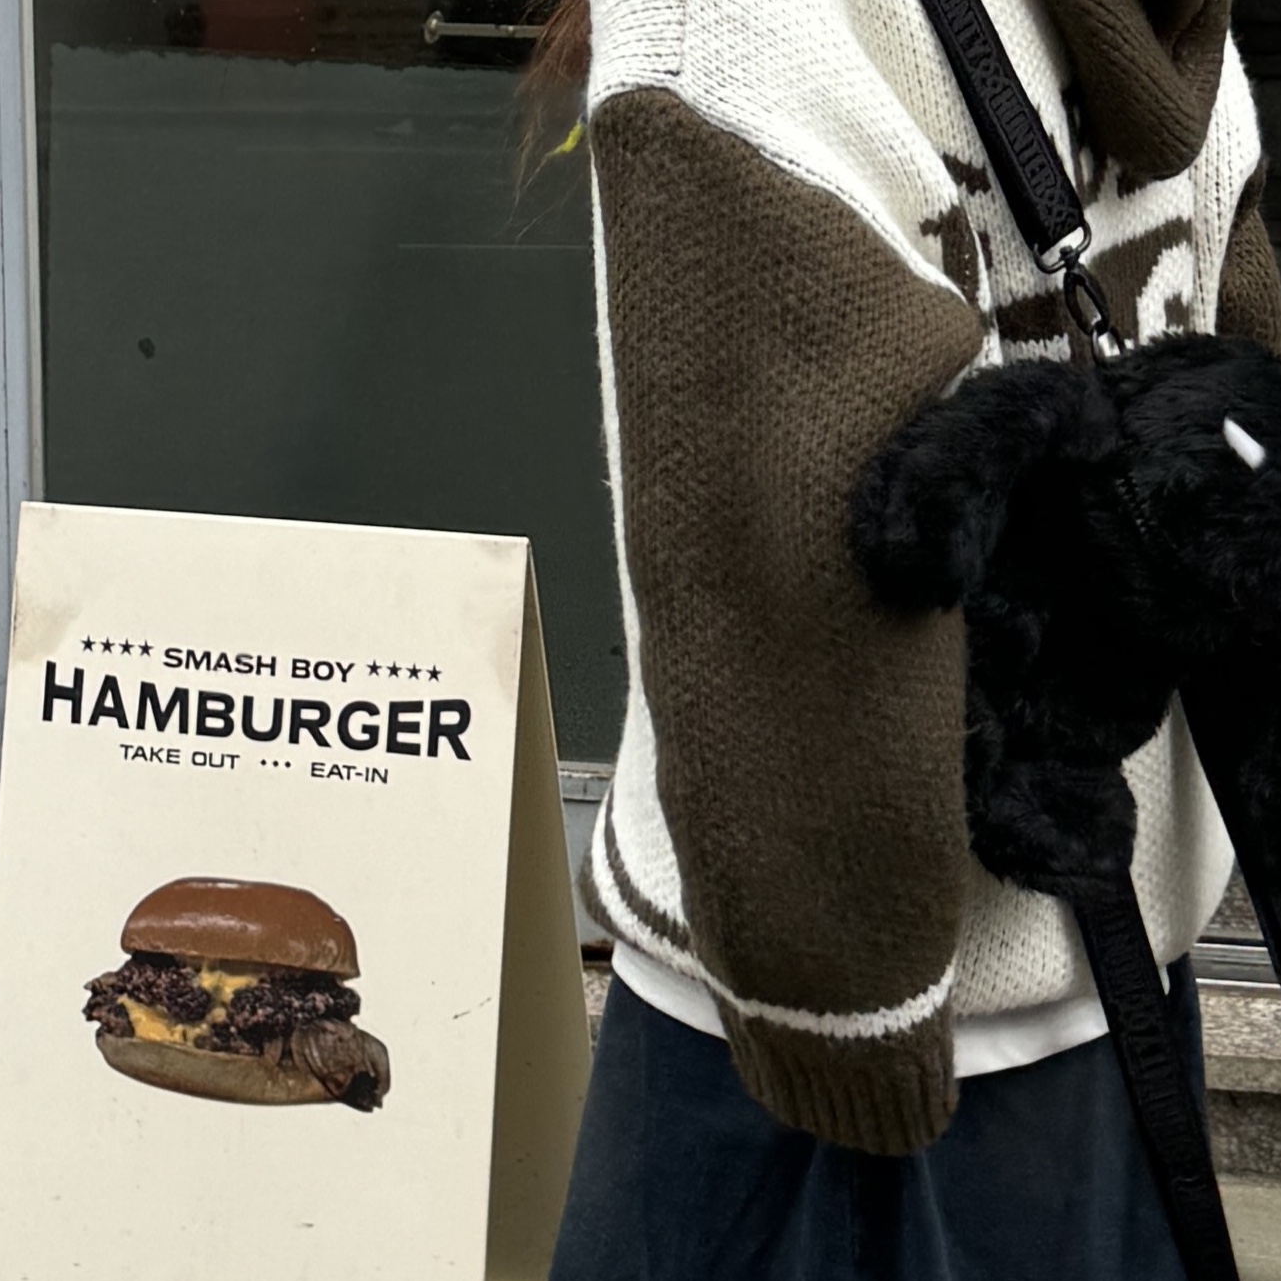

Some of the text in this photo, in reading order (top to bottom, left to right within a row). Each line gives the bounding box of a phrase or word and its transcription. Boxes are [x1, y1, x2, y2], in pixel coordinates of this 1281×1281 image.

[163, 647, 356, 683] SMASH BOY
[42, 660, 473, 762] HAMBURGER
[119, 743, 389, 784] TAKE OUT EAT-IN
